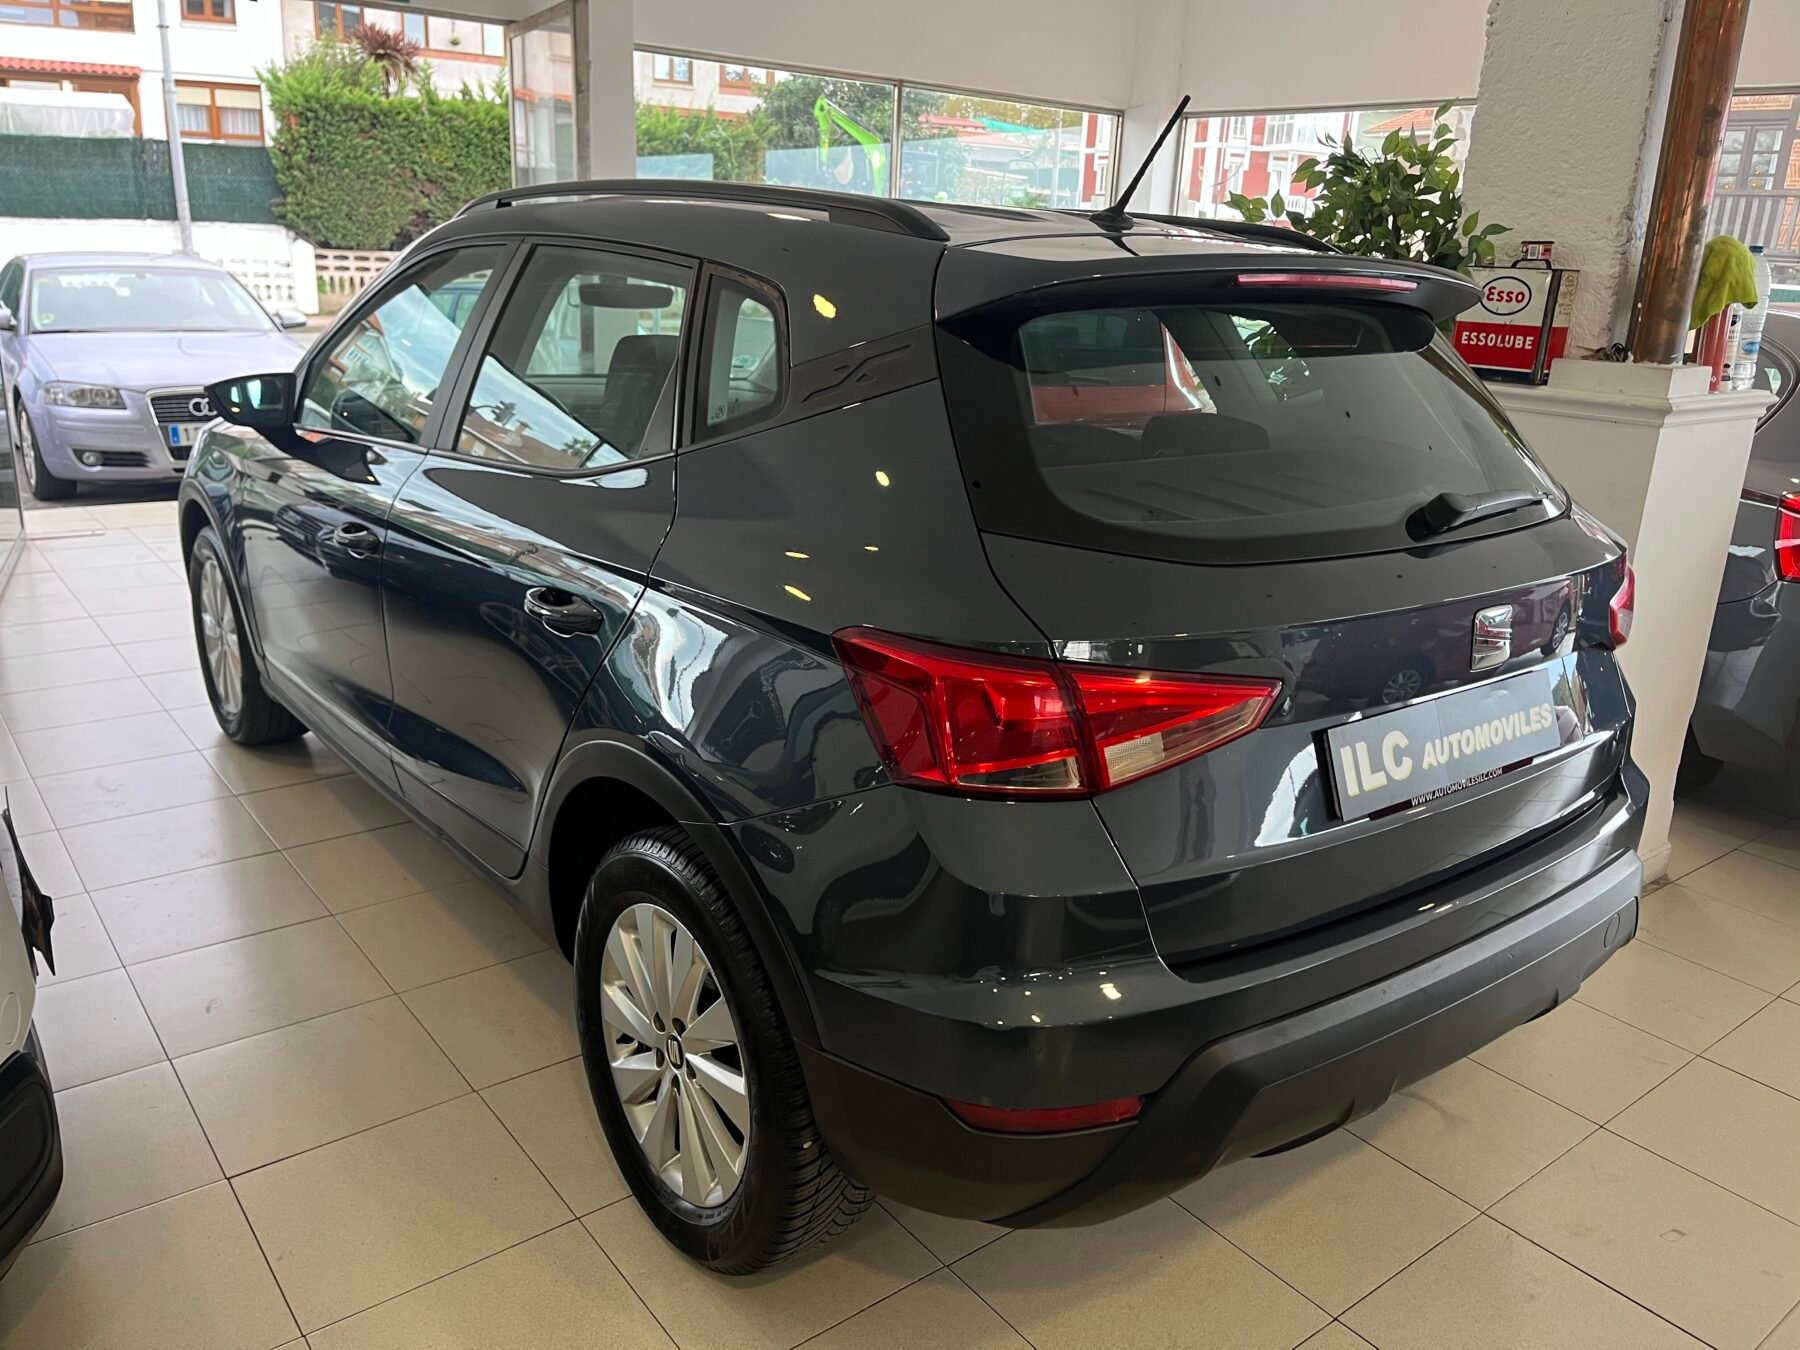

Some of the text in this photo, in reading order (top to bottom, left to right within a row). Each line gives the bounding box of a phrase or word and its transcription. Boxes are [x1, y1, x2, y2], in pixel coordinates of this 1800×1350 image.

[1461, 331, 1534, 349] ESSOLUBE
[1340, 702, 1554, 797] ILC AUTOMOVILES
[1411, 767, 1503, 806] WWW.AUTOMOVILESILC.COM
